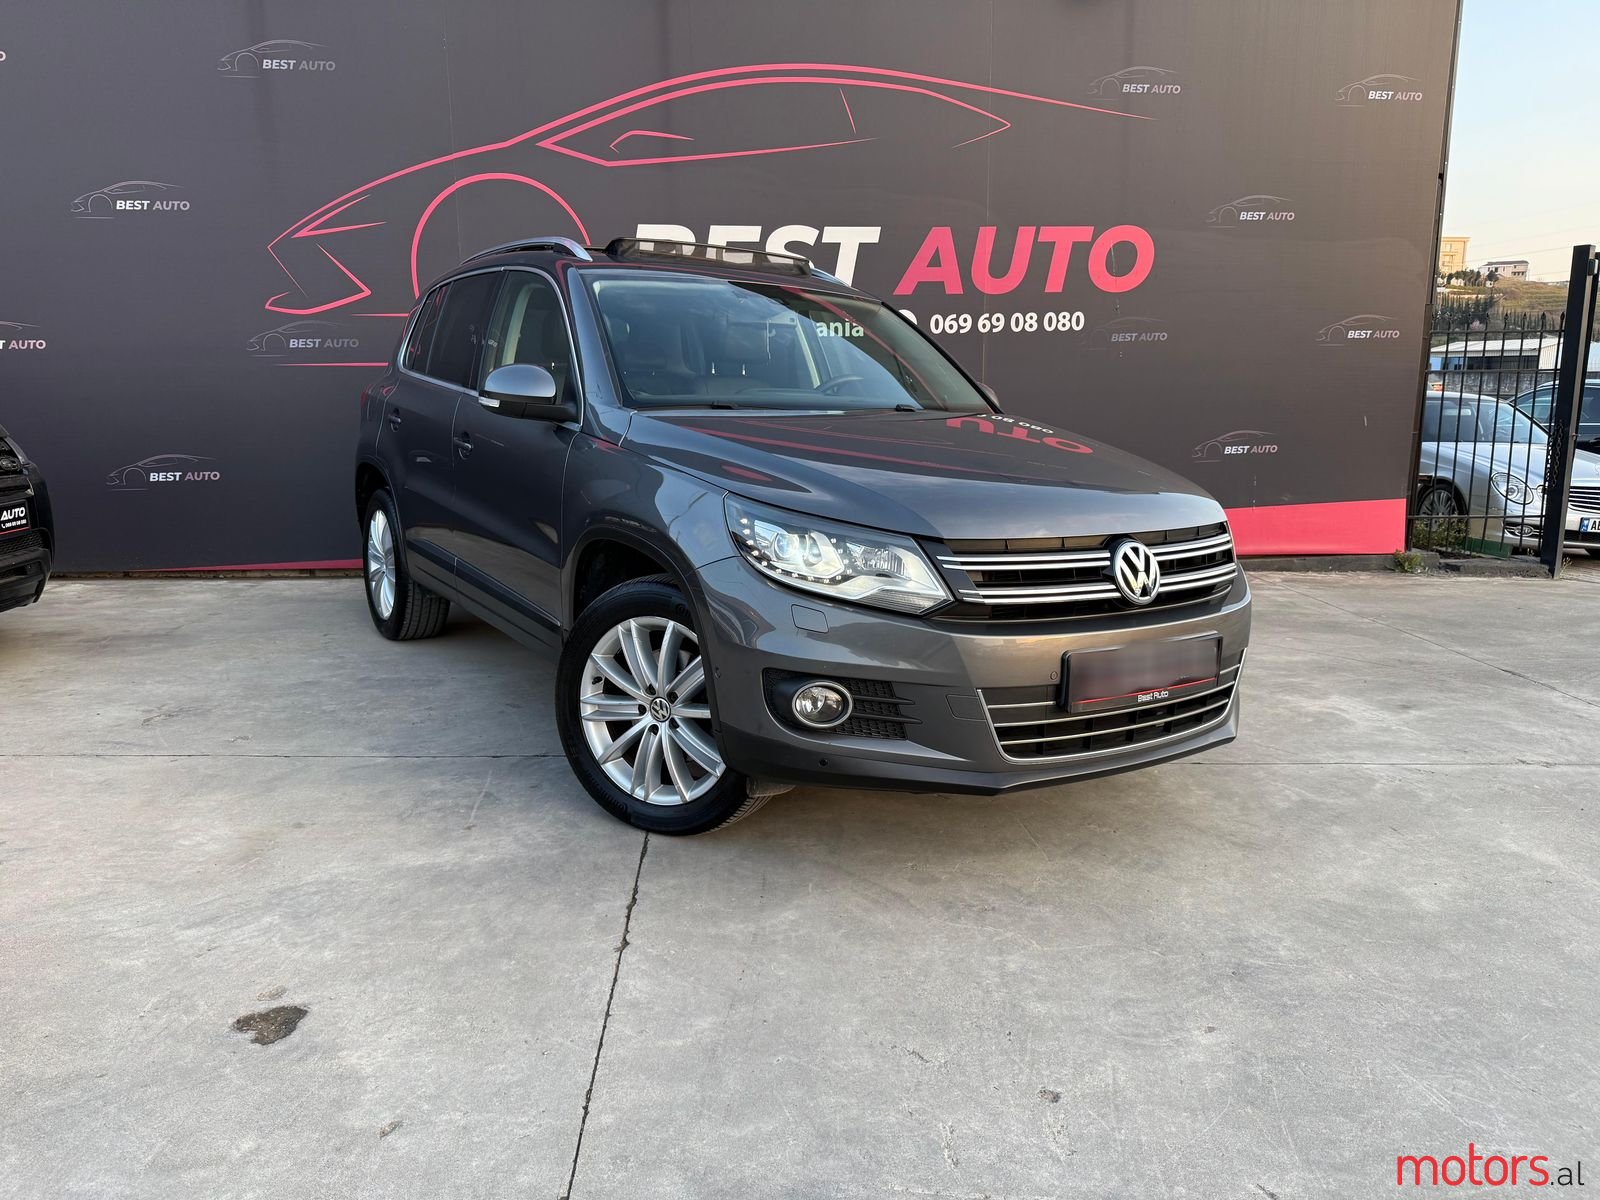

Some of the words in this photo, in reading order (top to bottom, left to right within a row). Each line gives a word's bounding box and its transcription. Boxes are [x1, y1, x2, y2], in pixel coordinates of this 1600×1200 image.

[262, 58, 296, 70] BEST
[298, 60, 336, 71] AUTO
[1122, 83, 1150, 93] BEST
[1151, 84, 1181, 94] AUTO
[1368, 90, 1394, 100] BEST
[1395, 91, 1423, 101] AUTO
[116, 200, 150, 211] BEST
[153, 200, 190, 211] AUTO
[1239, 211, 1266, 220] BEST
[1267, 211, 1295, 221] AUTO
[893, 225, 1155, 295] AUTO
[815, 318, 865, 337] ania
[929, 314, 972, 334] 069
[977, 313, 1005, 333] 69
[1010, 312, 1038, 332] 08
[1043, 311, 1086, 332] 080
[1111, 332, 1138, 342] BEST
[1139, 332, 1168, 342] AUTO
[1347, 330, 1373, 339] BEST
[1373, 330, 1400, 339] AUTO
[8, 339, 47, 350] AUTO
[289, 338, 321, 348] BEST
[324, 338, 360, 348] AUTO
[1224, 445, 1250, 455] BEST
[1250, 444, 1278, 454] AUTO
[149, 471, 182, 482] BEST
[184, 471, 221, 481] AUTO
[0, 506, 26, 521] AUTO
